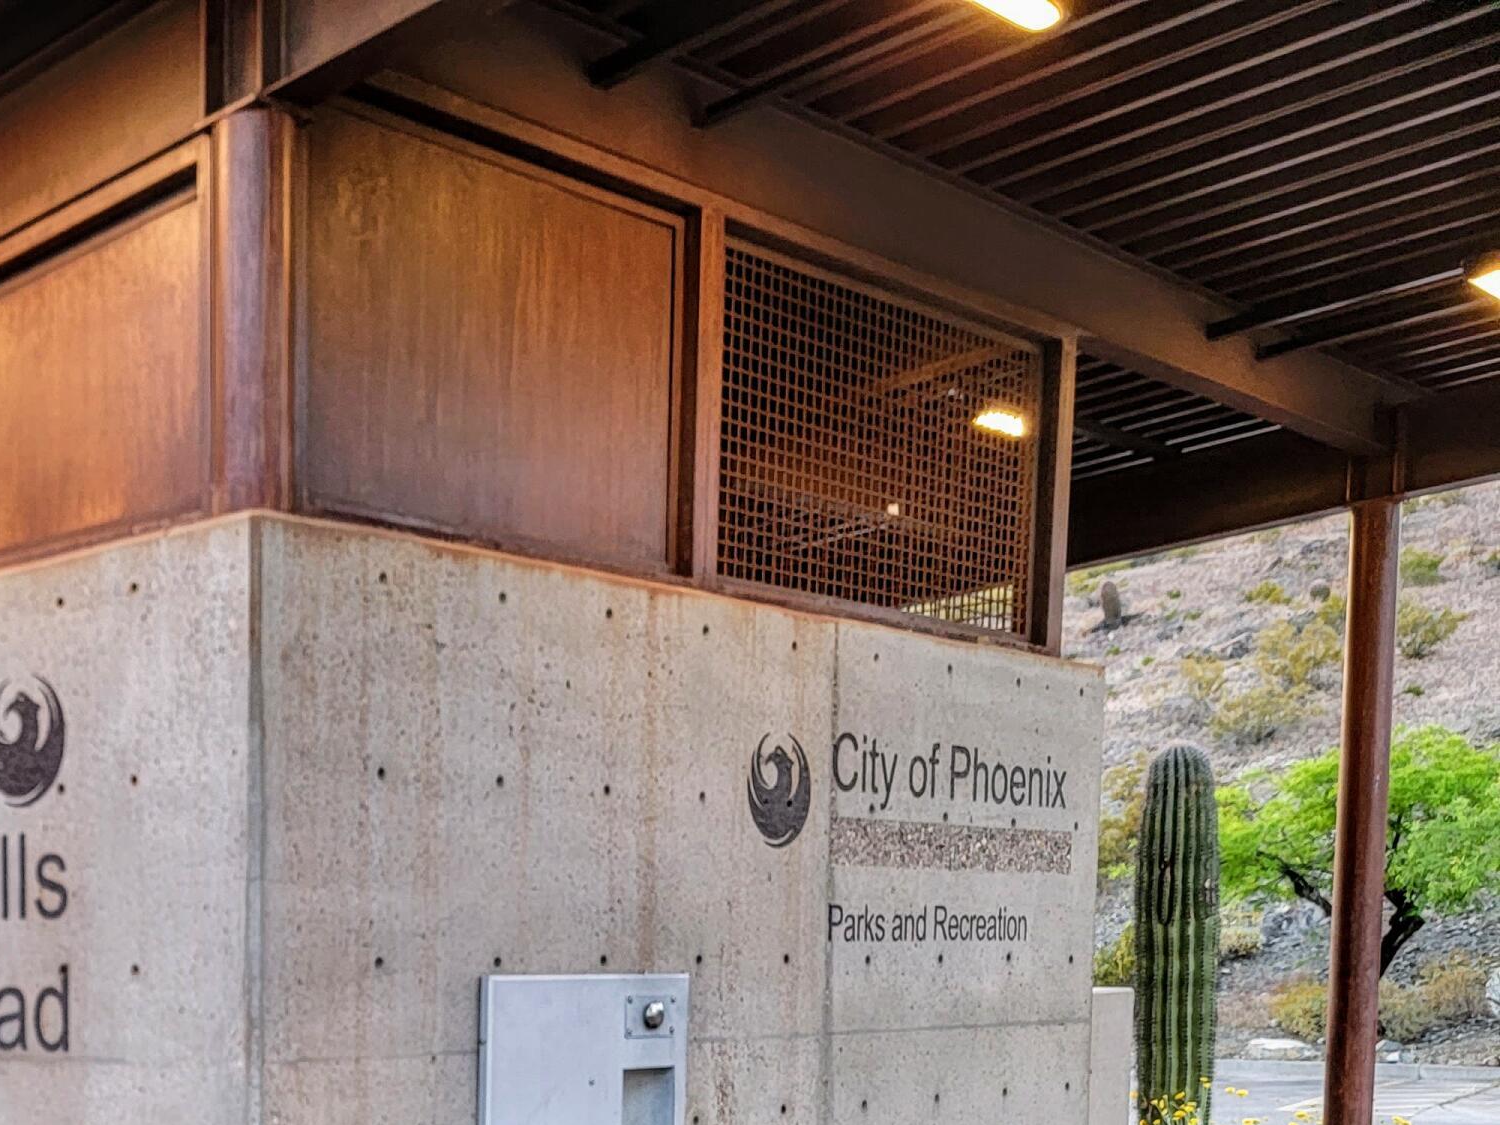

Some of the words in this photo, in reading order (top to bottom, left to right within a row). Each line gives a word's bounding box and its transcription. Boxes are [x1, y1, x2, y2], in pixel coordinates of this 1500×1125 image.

[833, 732, 898, 810] City
[909, 743, 940, 799] of
[950, 745, 1067, 809] Phoenix
[828, 904, 885, 943] Parks
[891, 906, 927, 942] and
[933, 905, 1028, 942] Recreation
